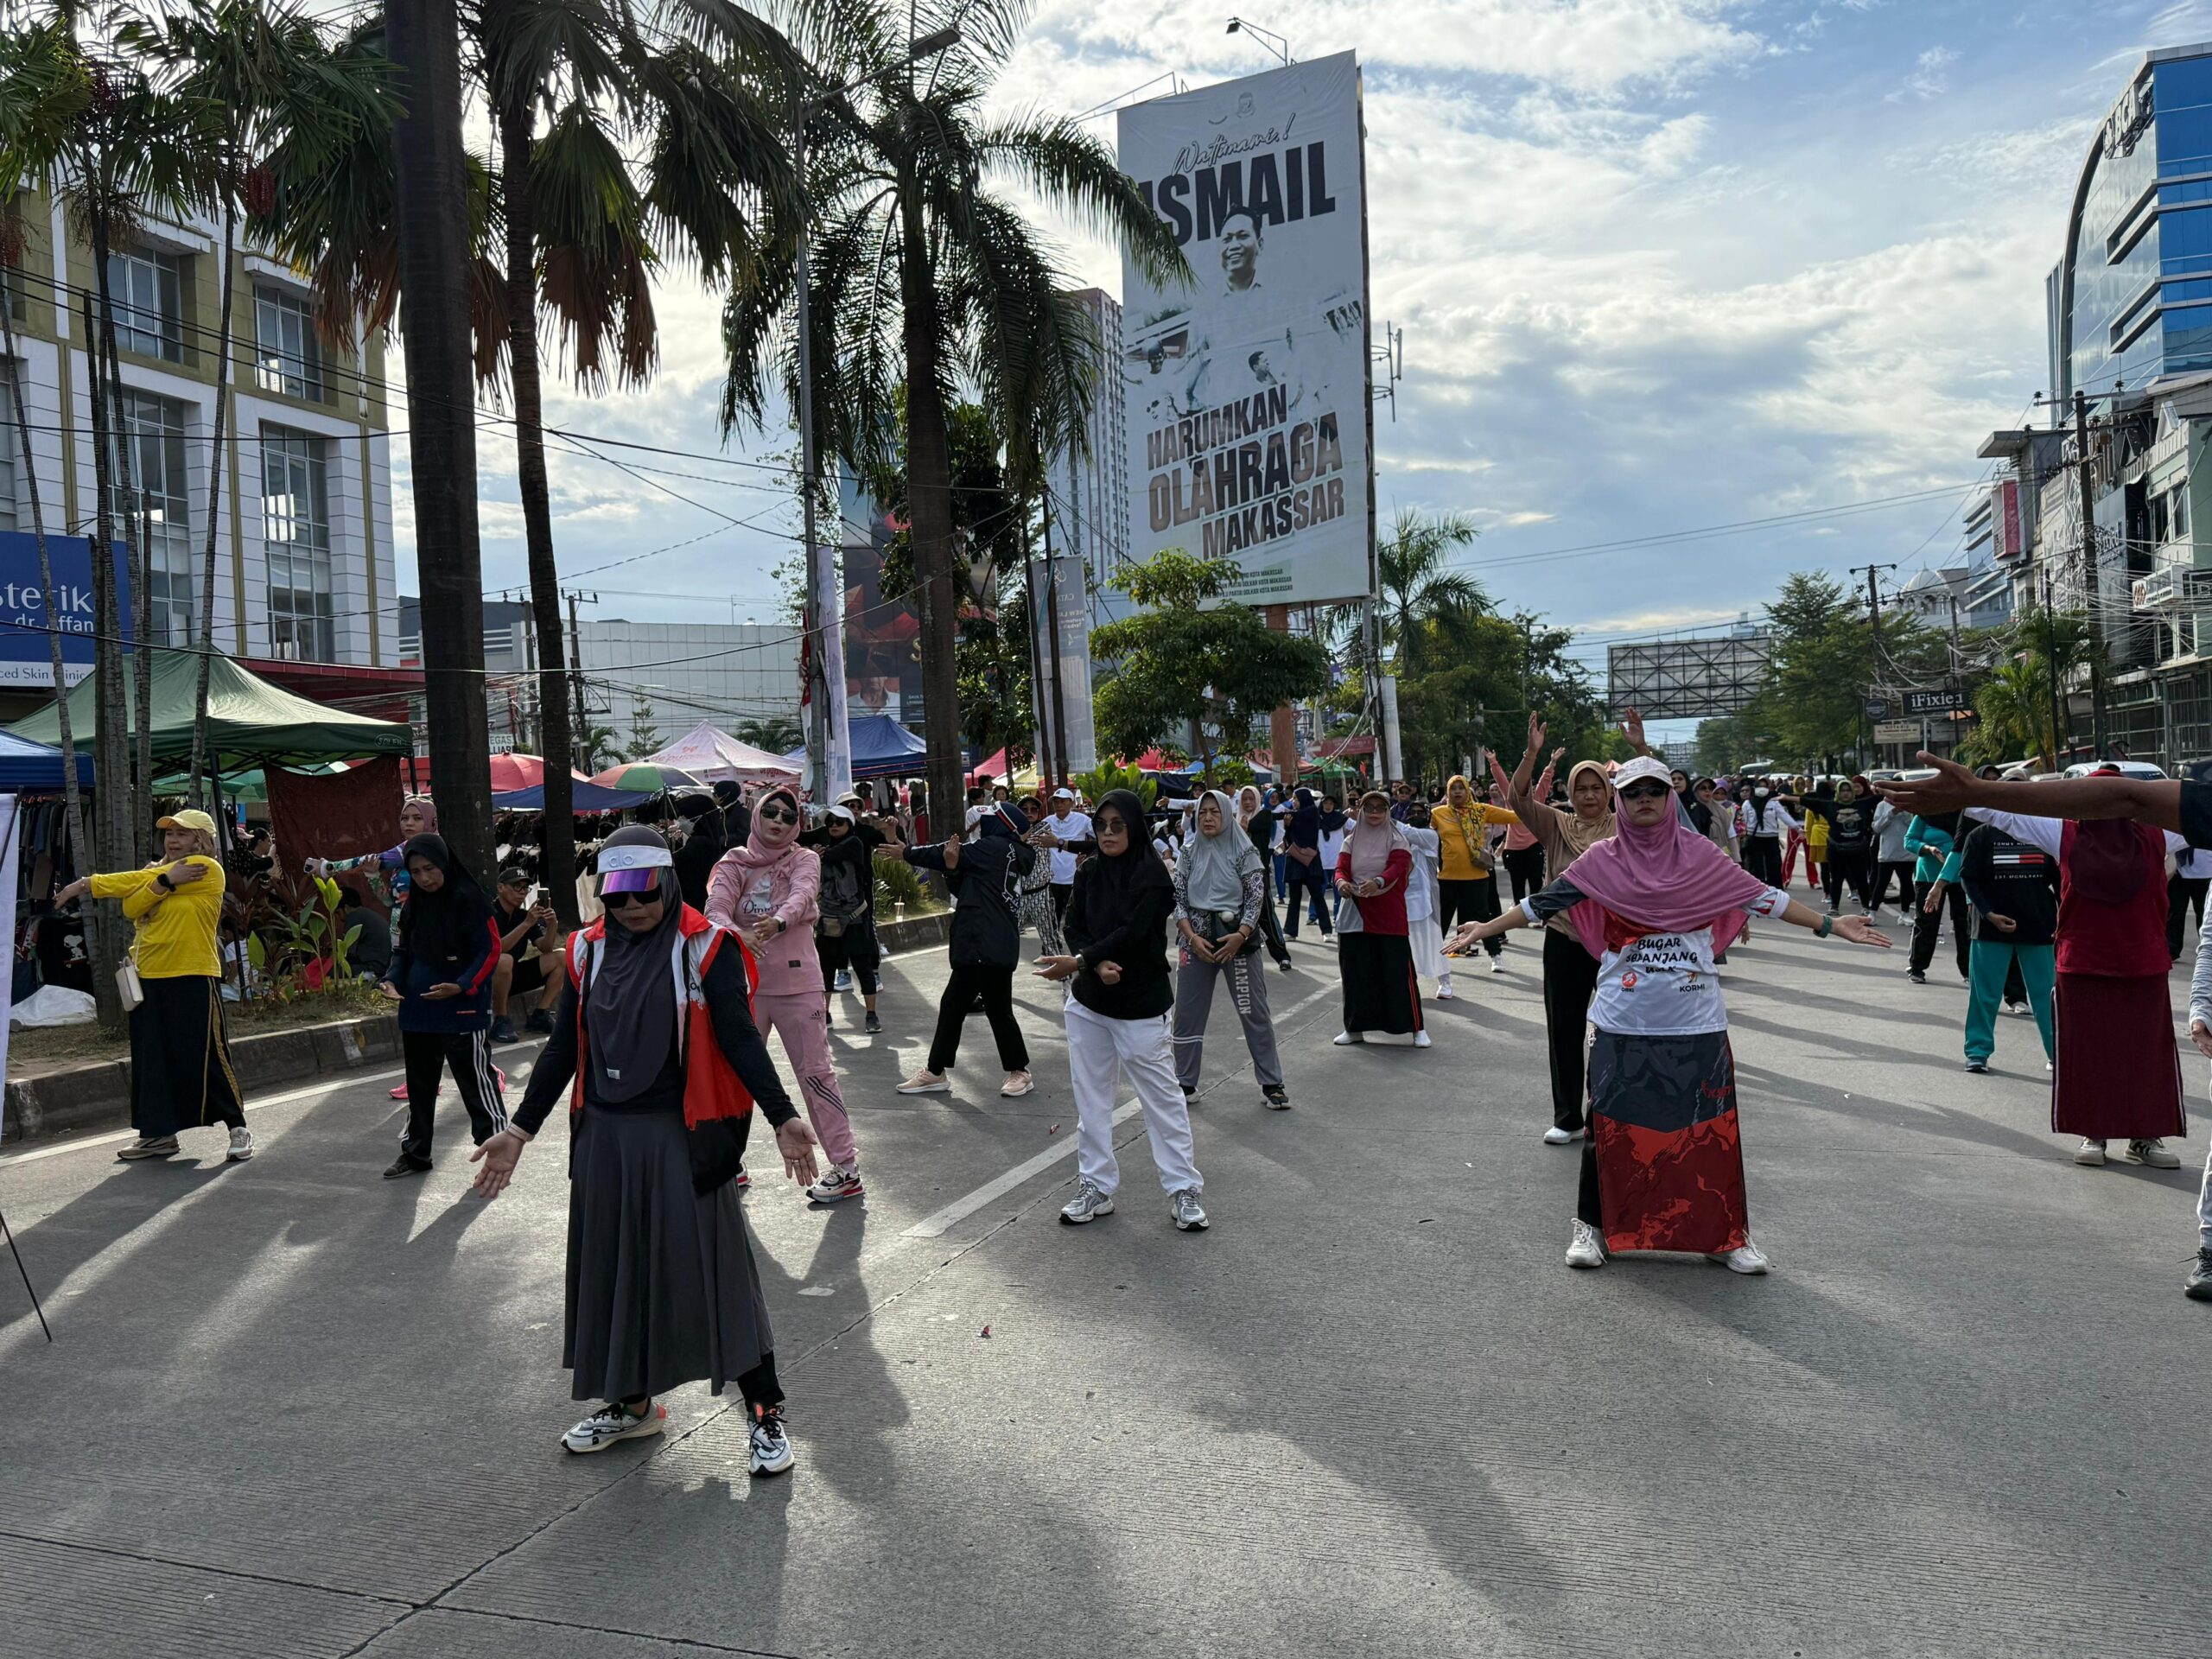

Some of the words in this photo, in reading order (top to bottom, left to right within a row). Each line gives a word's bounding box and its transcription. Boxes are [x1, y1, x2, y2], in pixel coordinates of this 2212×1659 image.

[1138, 141, 1336, 247] ISMAIL
[1147, 383, 1287, 471] HARUMKAN
[1148, 411, 1343, 533] OLAHRAGA
[1202, 477, 1344, 561] MAKASSAR
[22, 668, 48, 680] Skin
[1637, 937, 1681, 950] BUGAR
[1234, 954, 1251, 1014] HAMPION
[1679, 983, 1706, 993] KORMI
